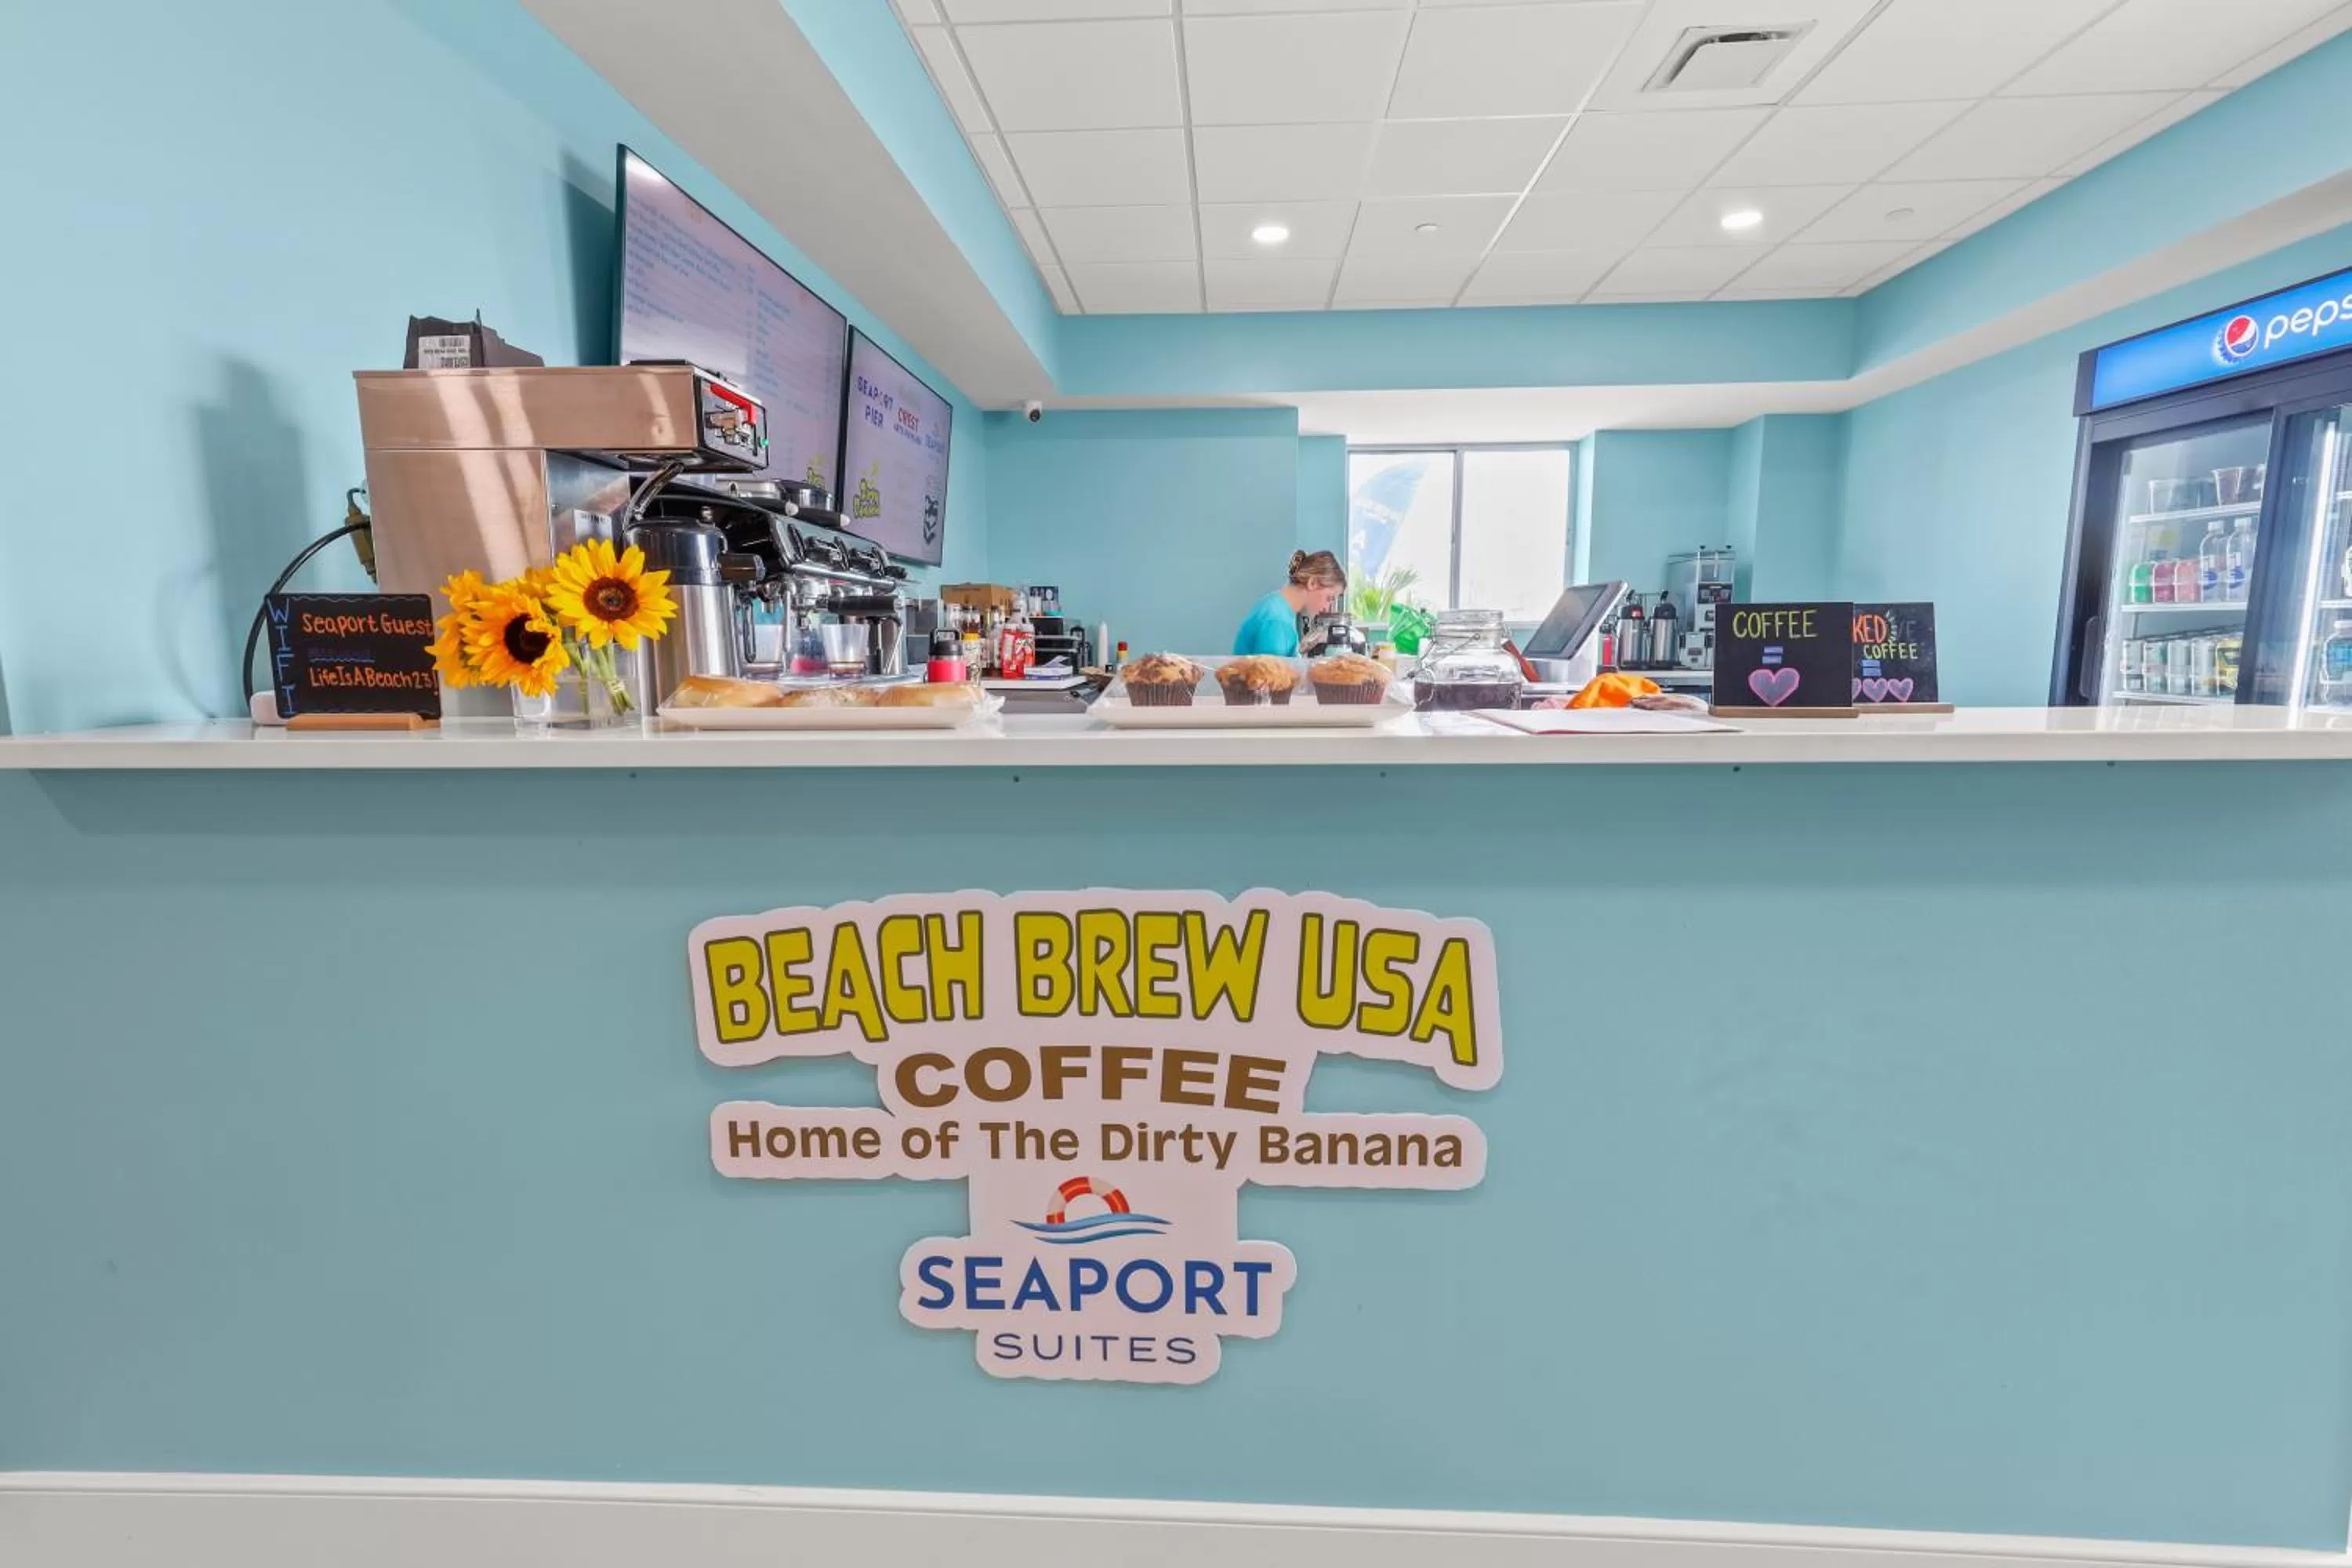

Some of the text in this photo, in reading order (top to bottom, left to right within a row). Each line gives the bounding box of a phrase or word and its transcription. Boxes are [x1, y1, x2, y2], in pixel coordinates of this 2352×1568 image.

[2263, 293, 2352, 350] peps
[301, 612, 379, 637] Seaport
[1733, 608, 1818, 638] COFFEE
[1853, 614, 1888, 644] KED
[1863, 643, 1918, 659] COFFEE
[704, 909, 1478, 1066] BEACH BREW USA
[895, 1045, 1287, 1114] COFFEE
[728, 1120, 1463, 1170] Home of The Dirty Banana
[917, 1256, 1272, 1316] SEAPORT
[993, 1334, 1197, 1364] SUITES
